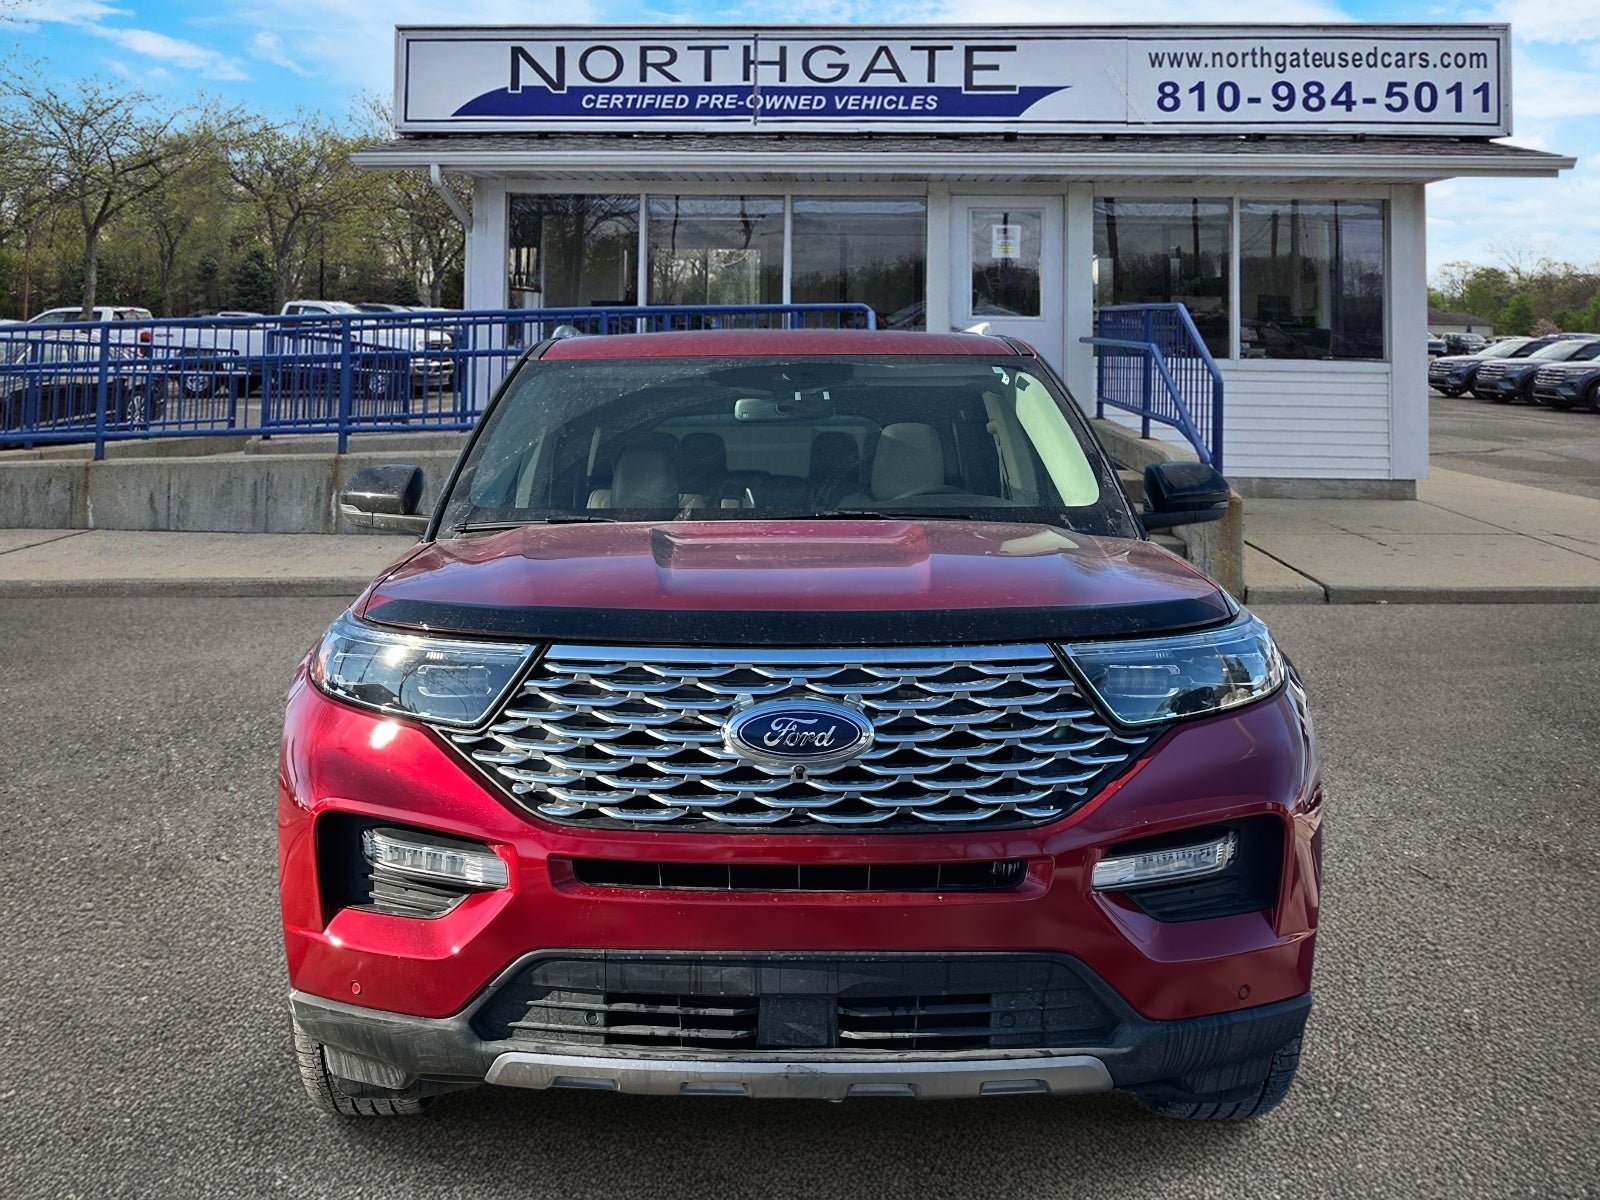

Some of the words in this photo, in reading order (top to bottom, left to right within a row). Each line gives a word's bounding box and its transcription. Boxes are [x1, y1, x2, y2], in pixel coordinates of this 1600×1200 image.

[509, 45, 1017, 92] NORTHGATE
[1148, 46, 1488, 73] www.northgateusedcars.com
[581, 93, 689, 111] CERTIFIED
[695, 93, 827, 111] PRE-OWNED
[834, 94, 938, 111] VEHICLES
[1157, 80, 1491, 113] 810-984-5011
[764, 717, 837, 747] Ford
